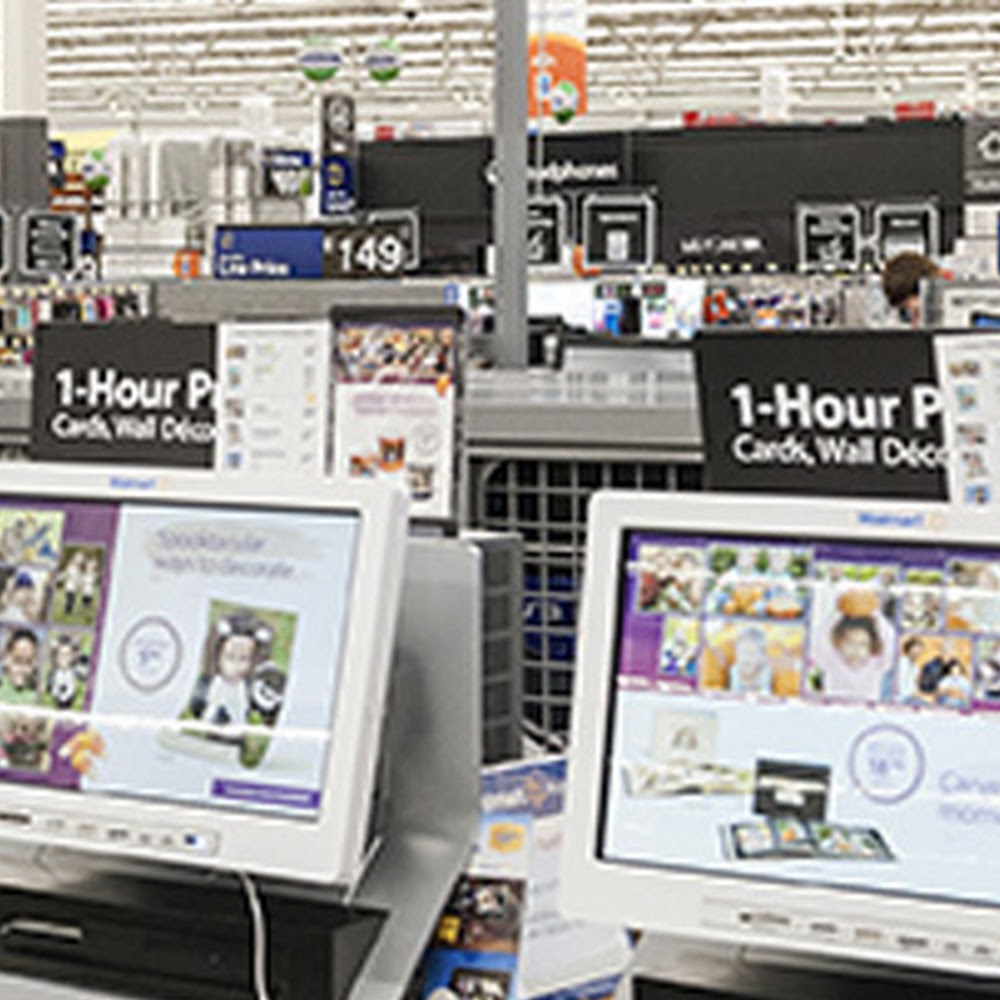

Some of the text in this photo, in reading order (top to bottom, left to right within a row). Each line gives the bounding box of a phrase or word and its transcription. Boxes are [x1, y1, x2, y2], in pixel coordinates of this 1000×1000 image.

[56, 368, 217, 410] 1-Hour P
[730, 383, 901, 430] 1-Hour
[111, 413, 157, 440] Wall
[732, 432, 816, 466] Cards,
[815, 436, 876, 465] Wall
